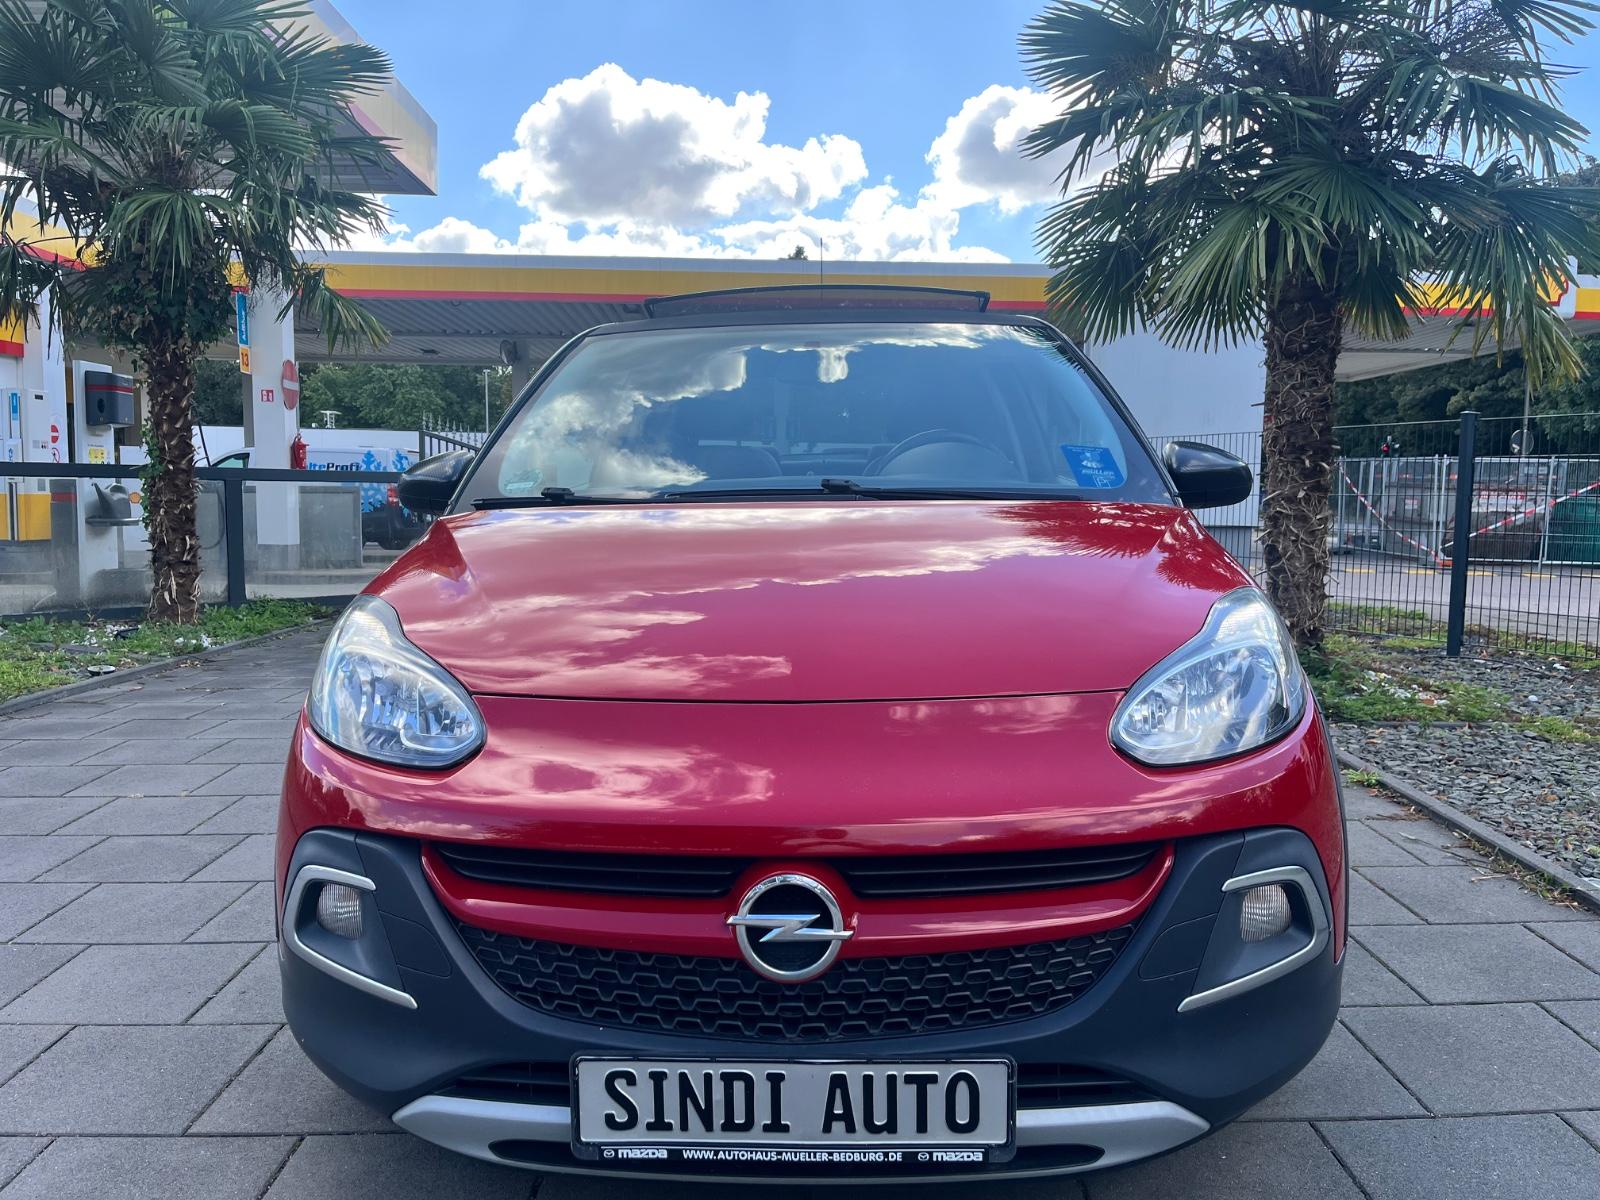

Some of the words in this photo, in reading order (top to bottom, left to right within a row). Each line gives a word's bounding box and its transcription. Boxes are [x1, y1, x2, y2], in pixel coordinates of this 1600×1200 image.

[241, 352, 249, 368] 13
[308, 462, 361, 471] lteProfi
[604, 1069, 790, 1133] SINDI
[822, 1070, 981, 1134] AUTO
[682, 1149, 903, 1162] WWW.AUTOHAUS-MUELLER-BEDBURG.DE
